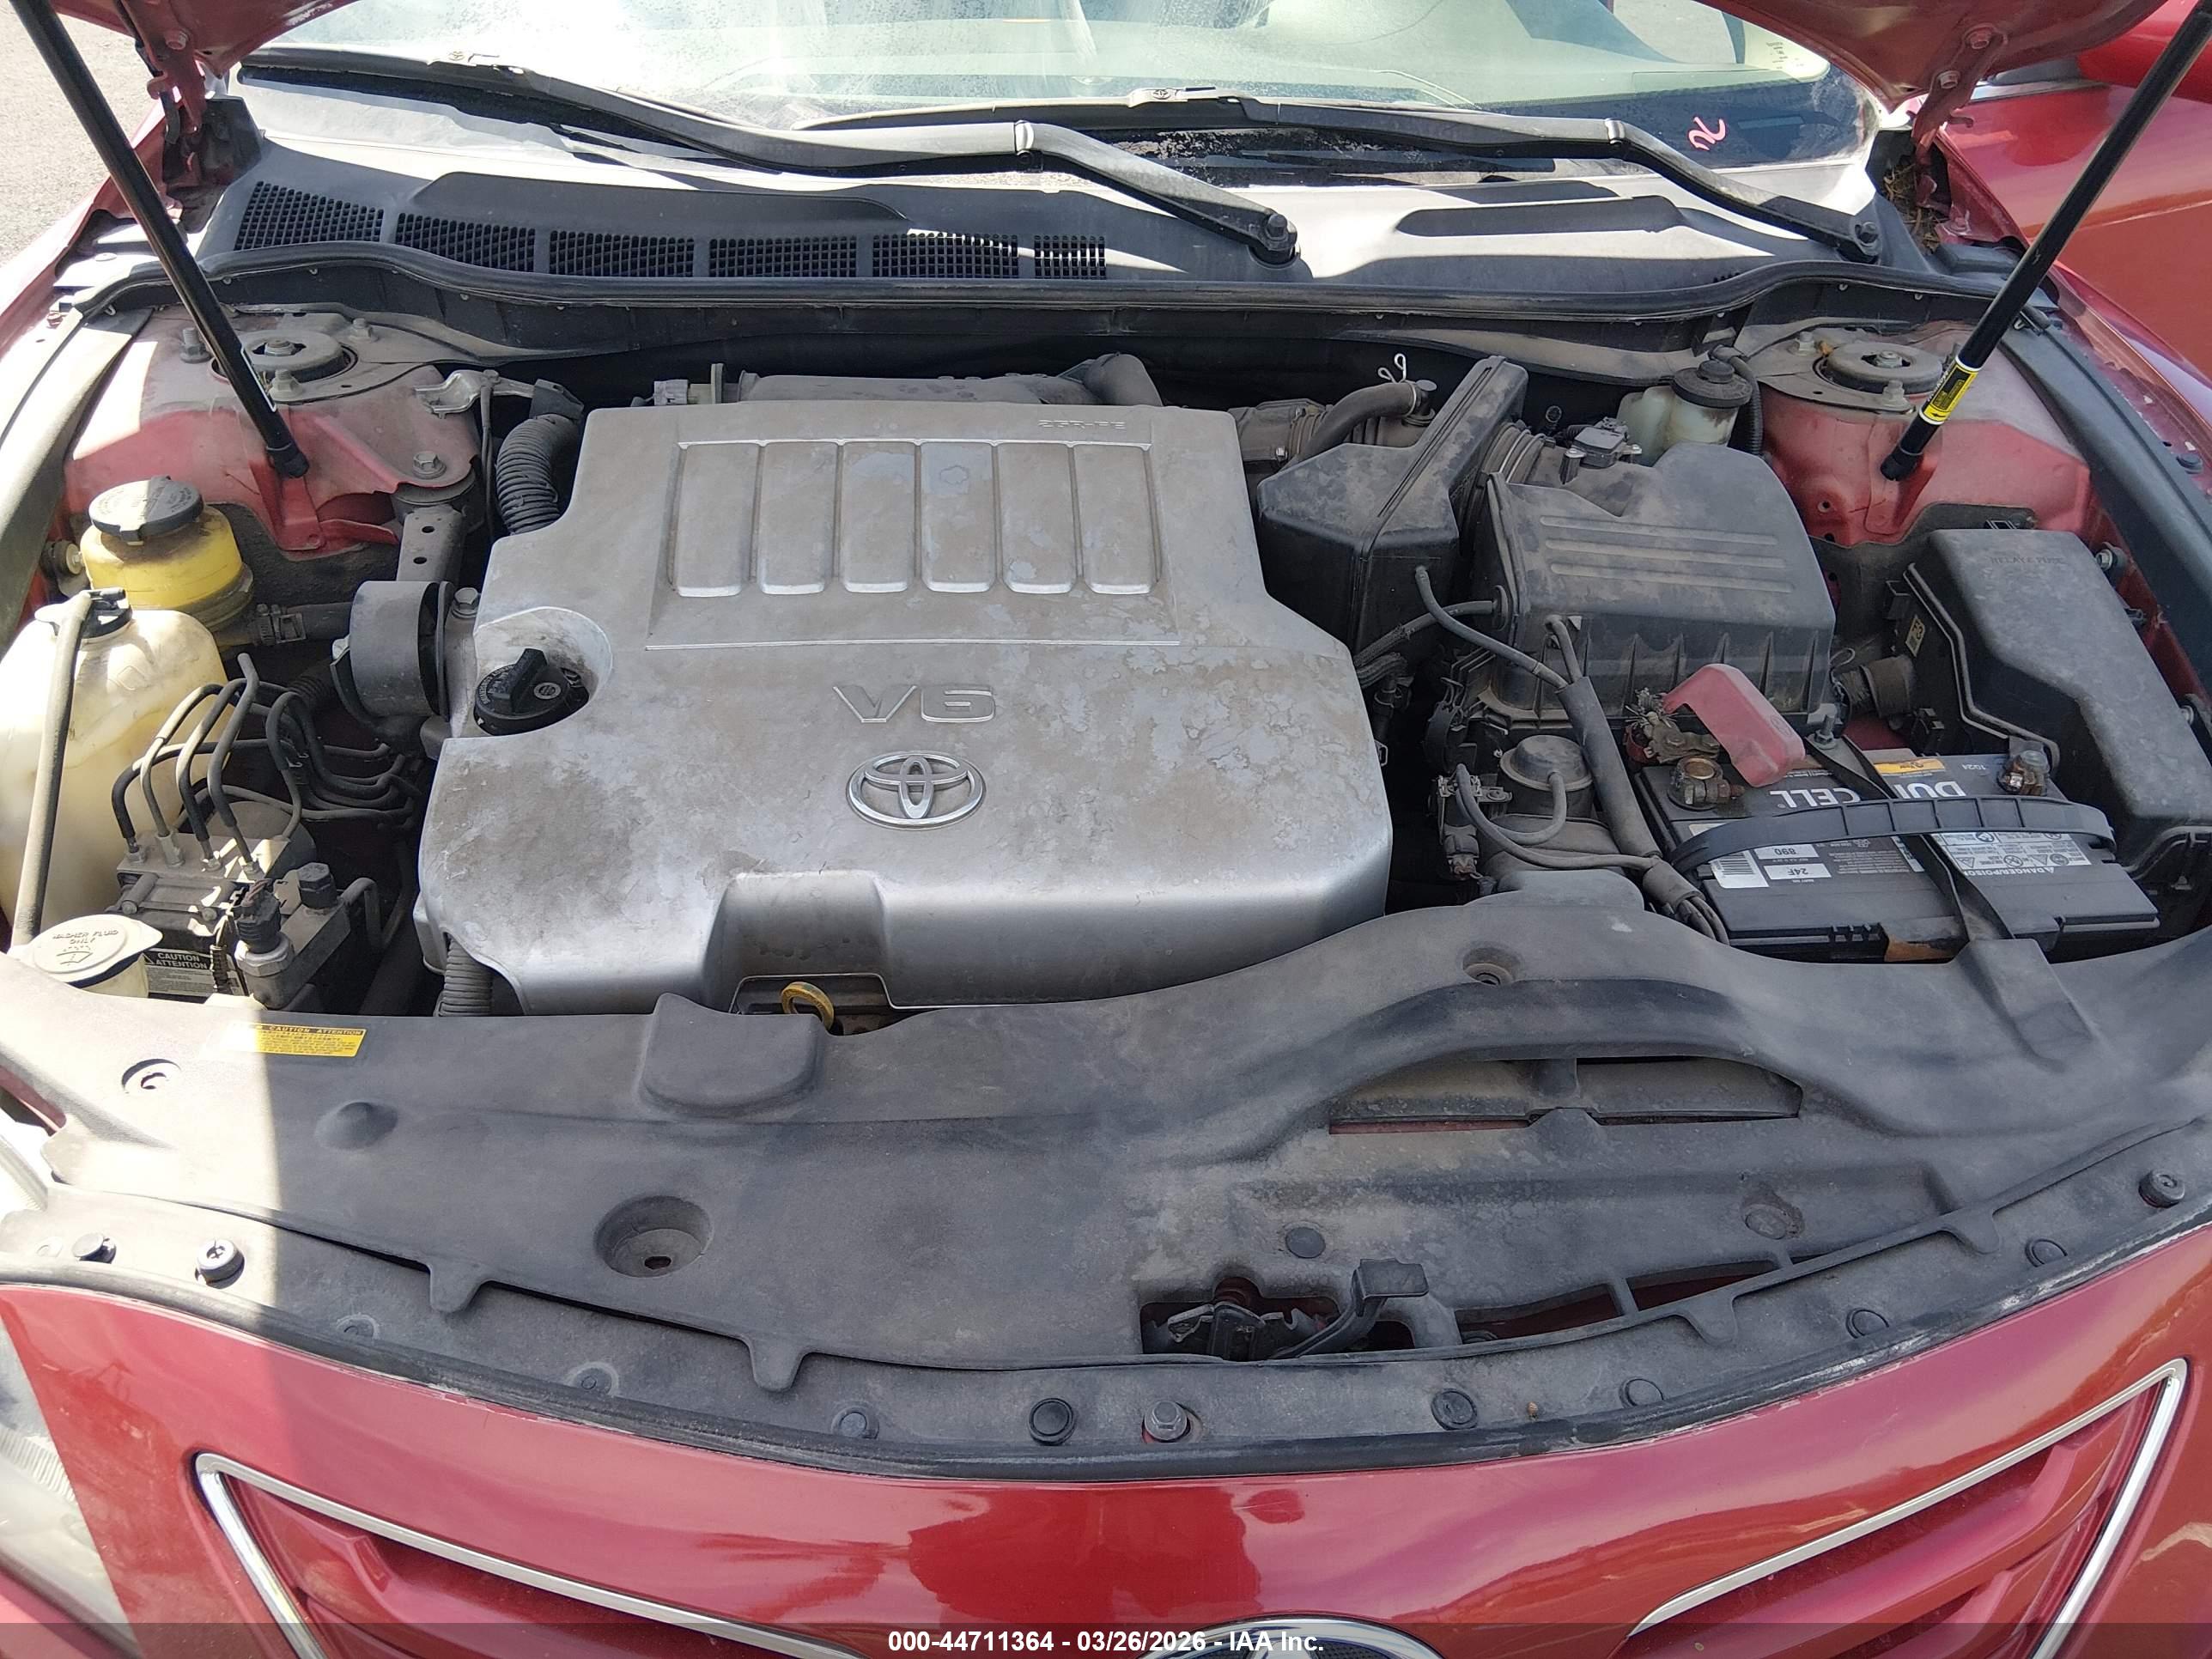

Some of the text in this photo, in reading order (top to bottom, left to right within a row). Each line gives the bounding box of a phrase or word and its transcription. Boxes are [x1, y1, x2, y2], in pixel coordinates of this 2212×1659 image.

[833, 684, 996, 724] V6
[1774, 848, 1797, 856] 890
[1787, 867, 1808, 876] 24F
[157, 952, 200, 962] CAUTION
[155, 959, 208, 969] ATTENTION
